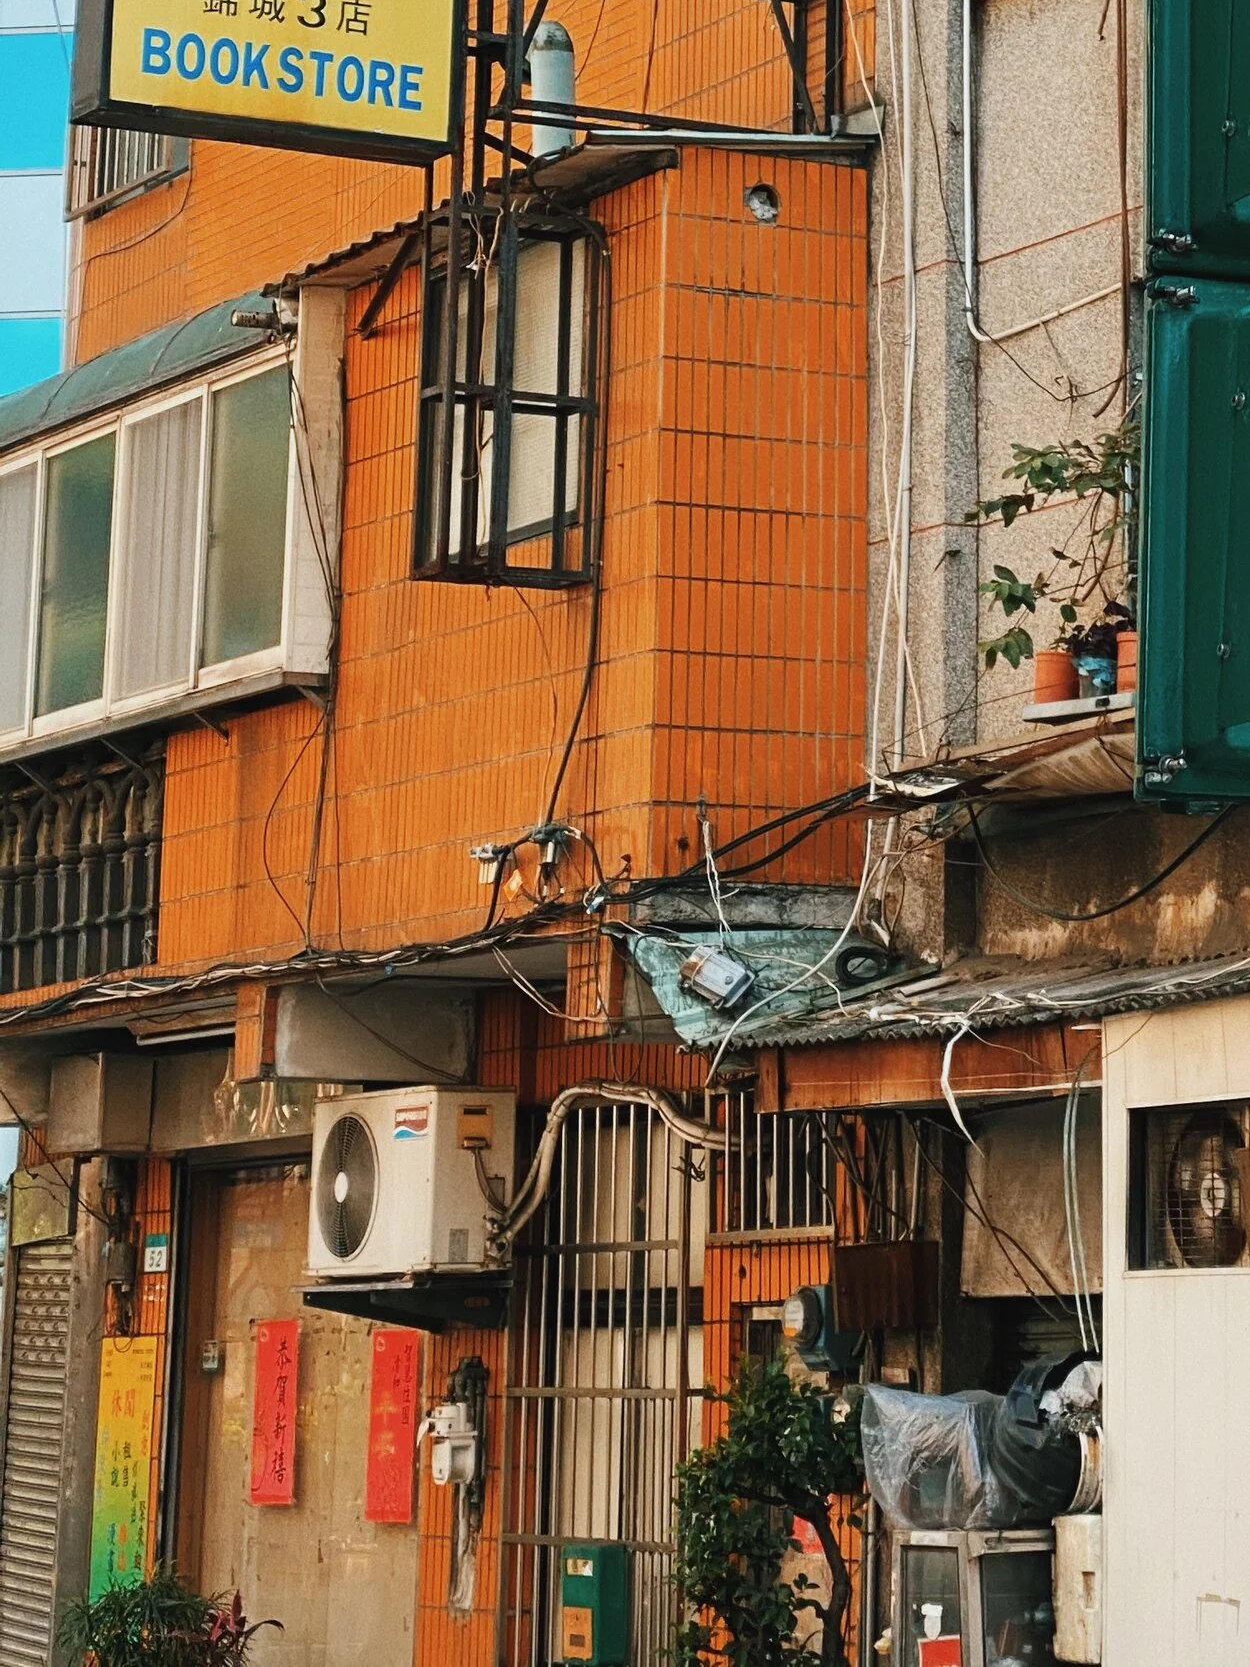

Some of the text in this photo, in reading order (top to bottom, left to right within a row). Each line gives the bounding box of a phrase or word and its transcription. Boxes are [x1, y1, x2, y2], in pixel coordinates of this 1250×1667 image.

[141, 27, 423, 111] BOOKSTORE
[148, 1250, 163, 1268] 52
[271, 1336, 292, 1484] 恭賀新禧
